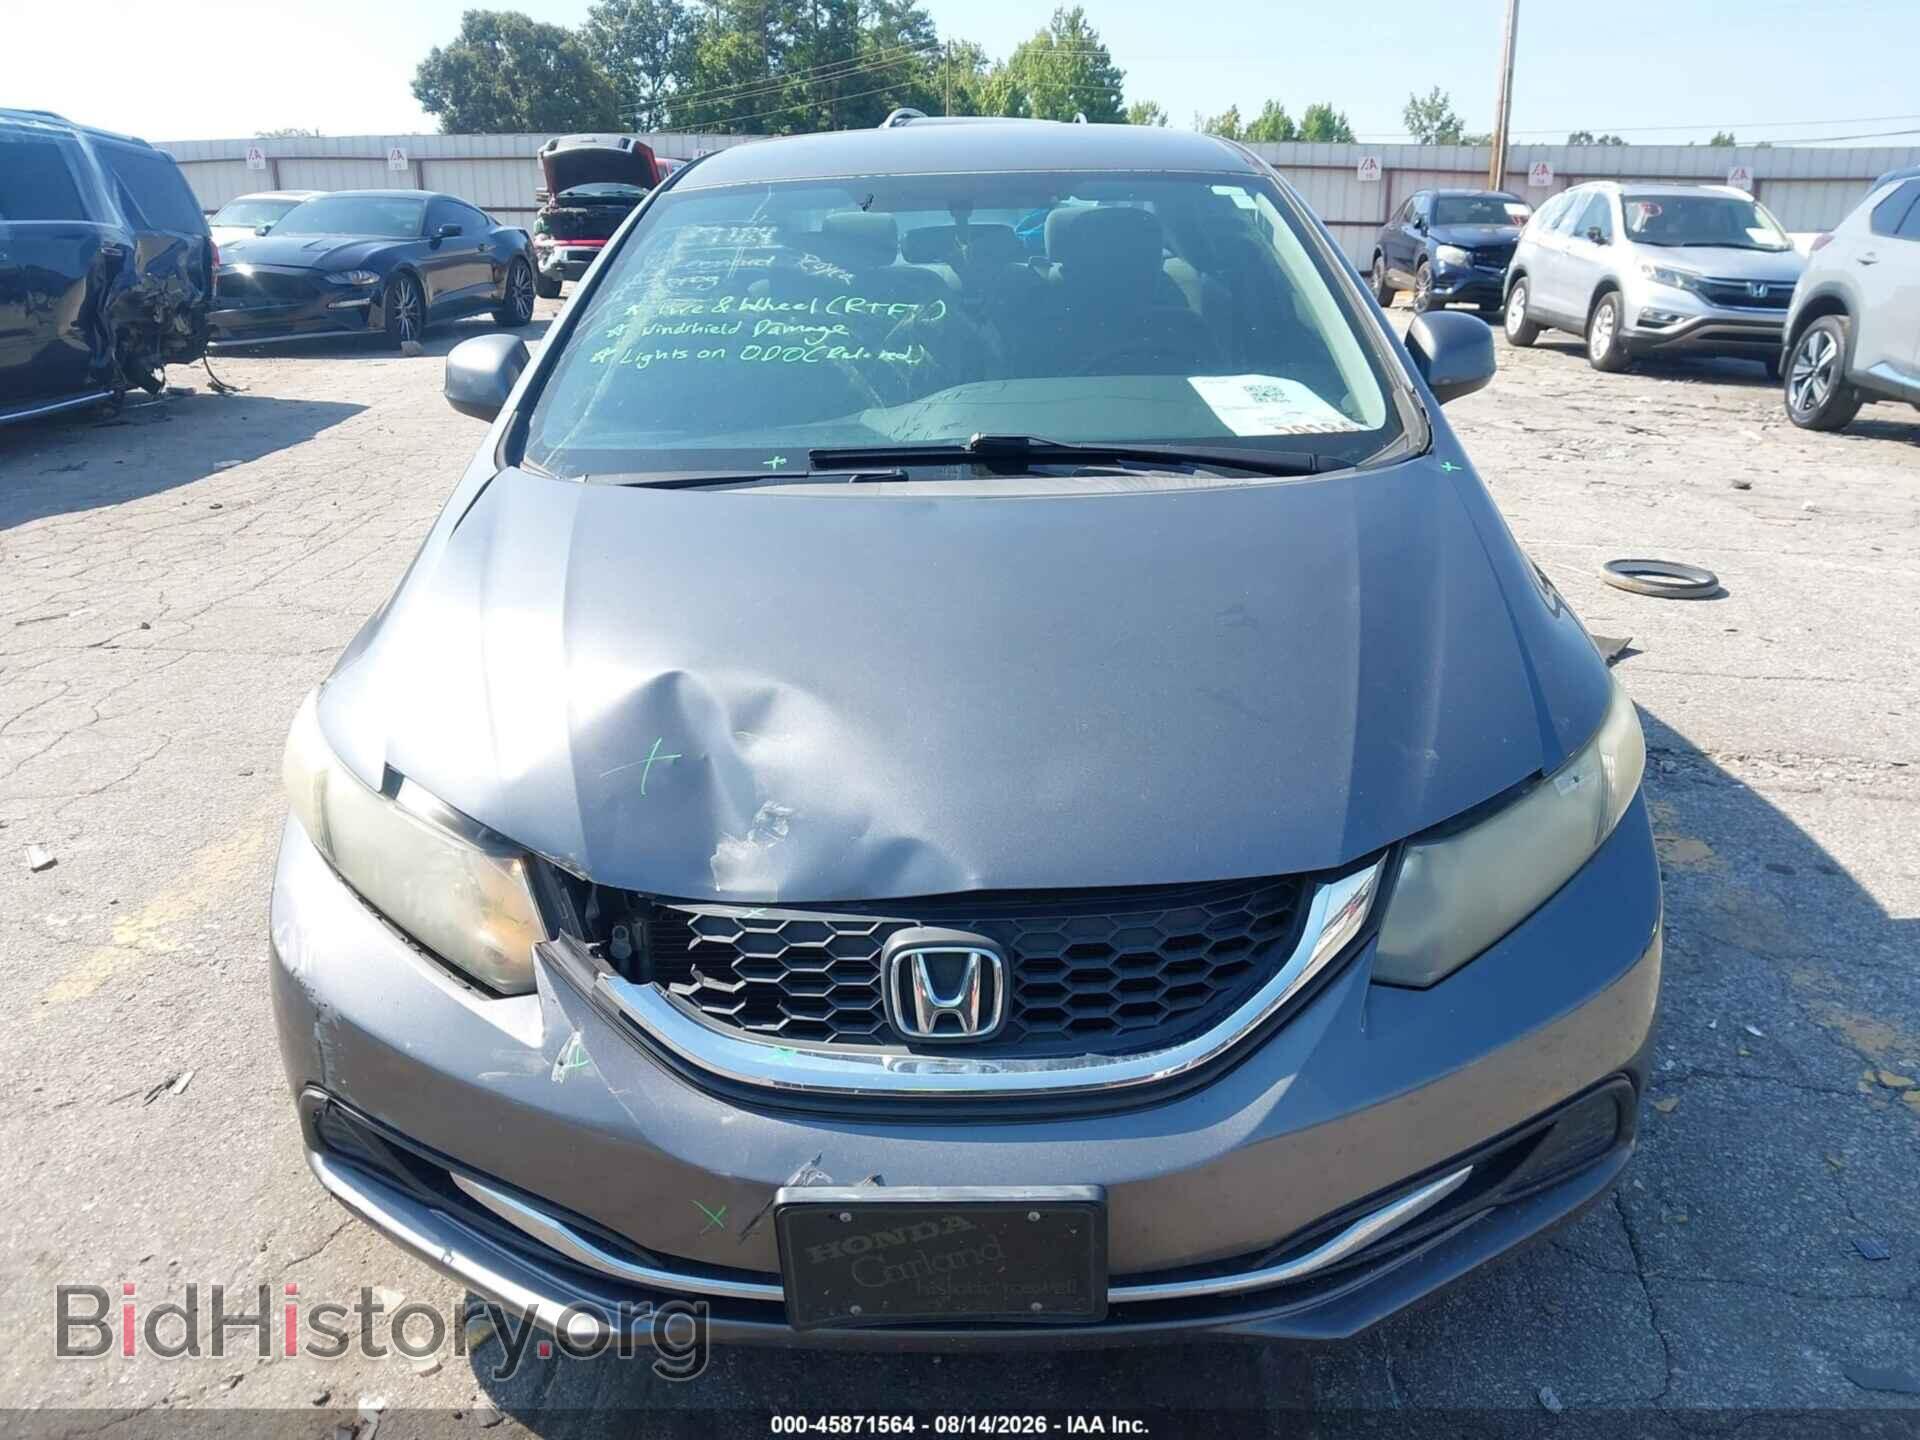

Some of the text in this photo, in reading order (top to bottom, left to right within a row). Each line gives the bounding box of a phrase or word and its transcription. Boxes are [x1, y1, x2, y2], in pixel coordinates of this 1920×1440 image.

[711, 295, 735, 314] &
[751, 318, 849, 346] Damage
[619, 348, 689, 370] Lights
[696, 348, 726, 359] on
[805, 1214, 977, 1264] HONDA
